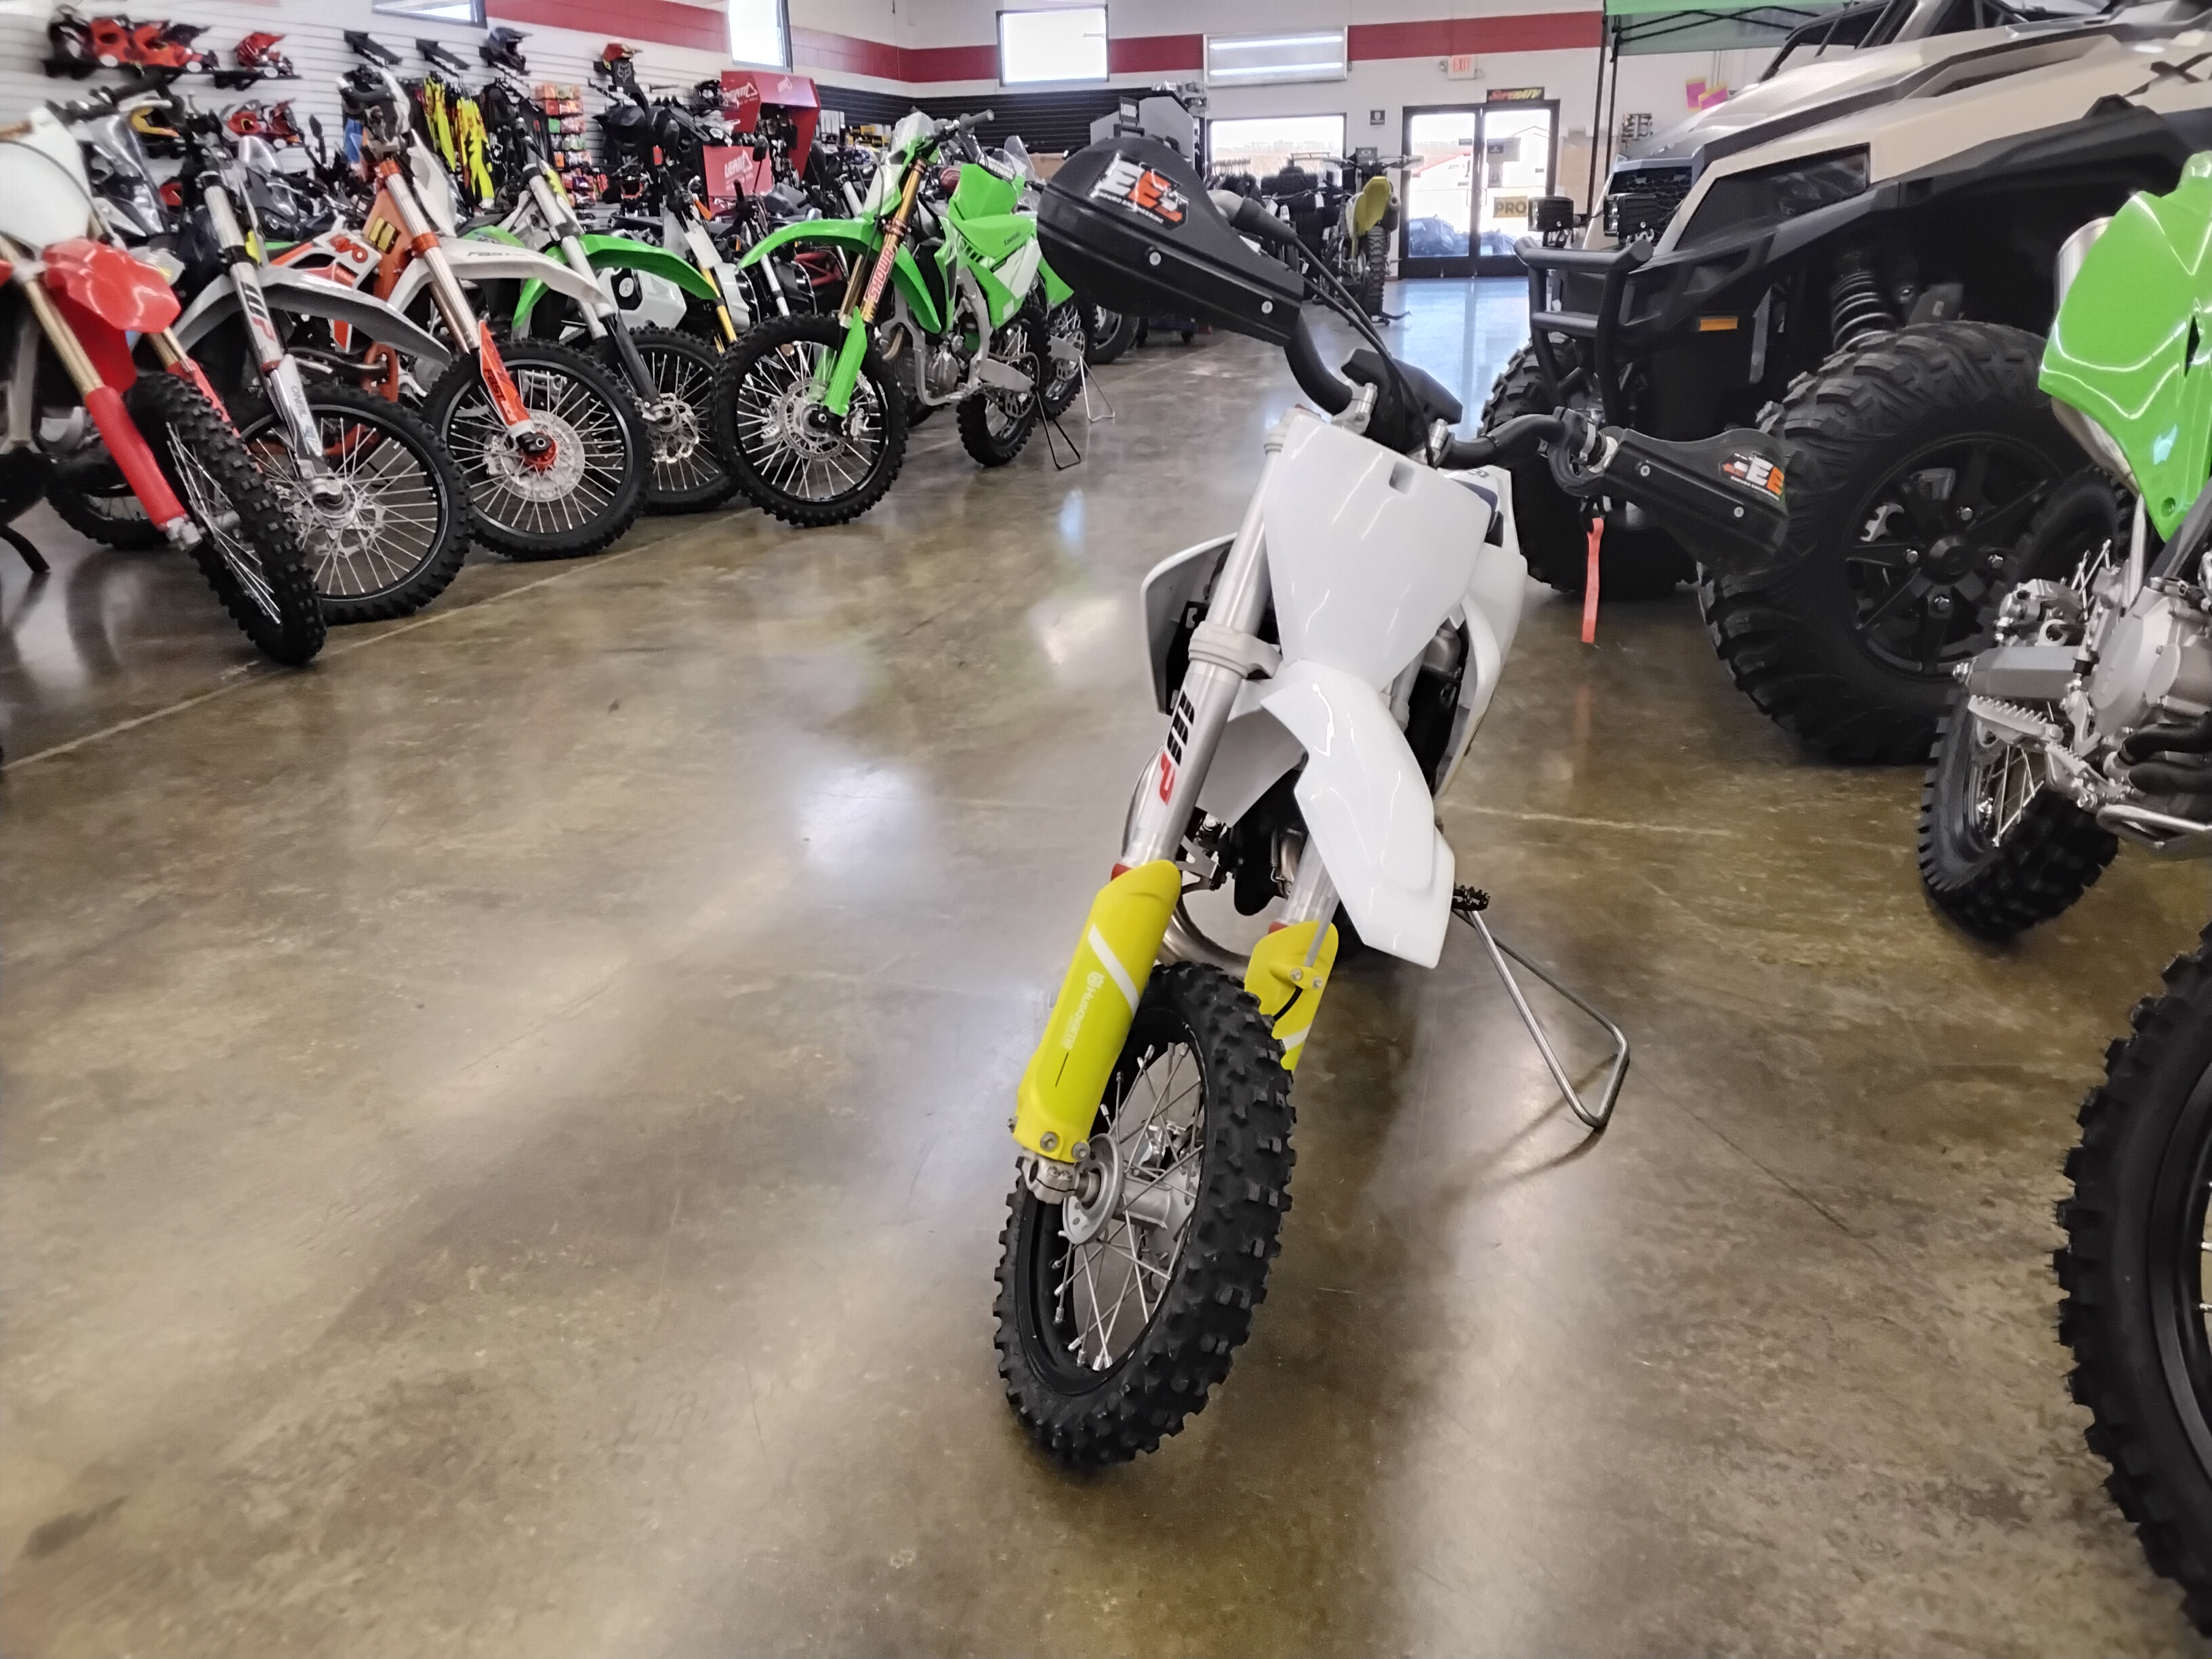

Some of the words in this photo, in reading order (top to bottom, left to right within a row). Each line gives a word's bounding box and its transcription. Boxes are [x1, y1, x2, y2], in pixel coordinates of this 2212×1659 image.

[1453, 55, 1471, 72] EXIT
[1495, 200, 1527, 214] PRO
[865, 246, 895, 302] SHOWA
[1730, 475, 1751, 487] ENDURO
